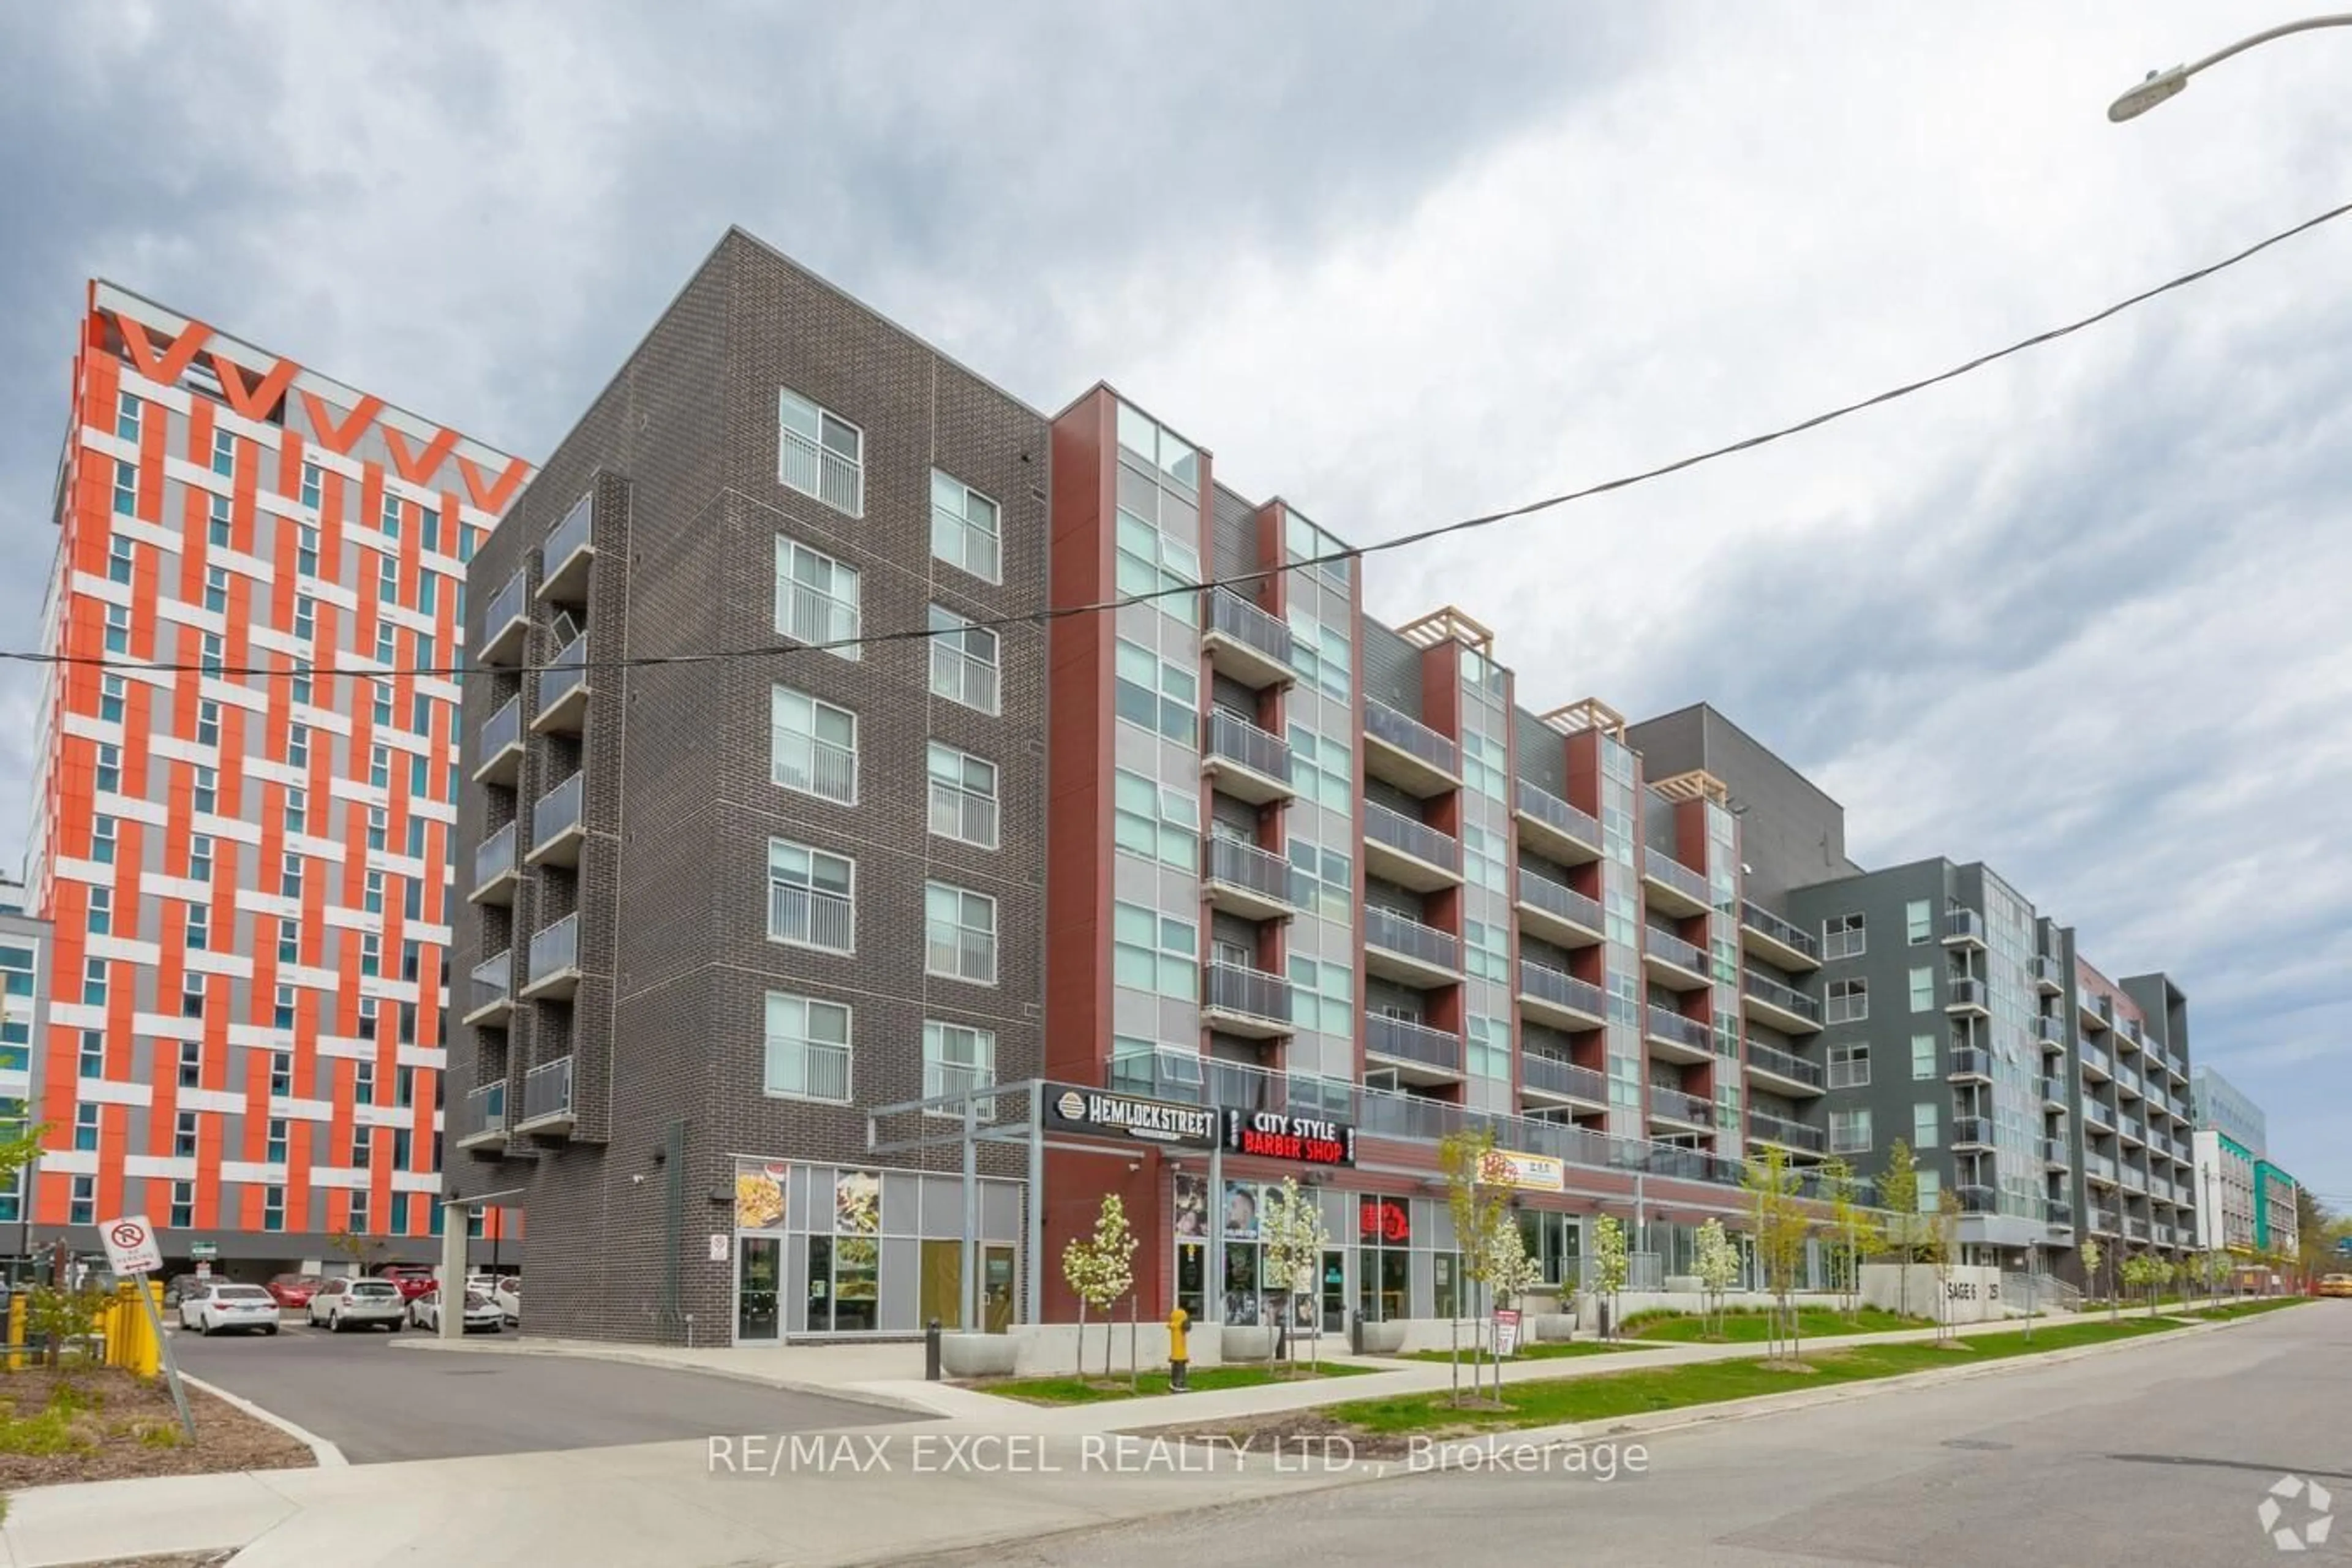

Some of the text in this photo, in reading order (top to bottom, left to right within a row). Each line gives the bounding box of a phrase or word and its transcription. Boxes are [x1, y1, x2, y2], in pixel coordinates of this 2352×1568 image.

[1254, 1112, 1336, 1141] CITY STYLE
[1244, 1130, 1342, 1164] BARBER SHOP
[1947, 1282, 1969, 1300] SAGE
